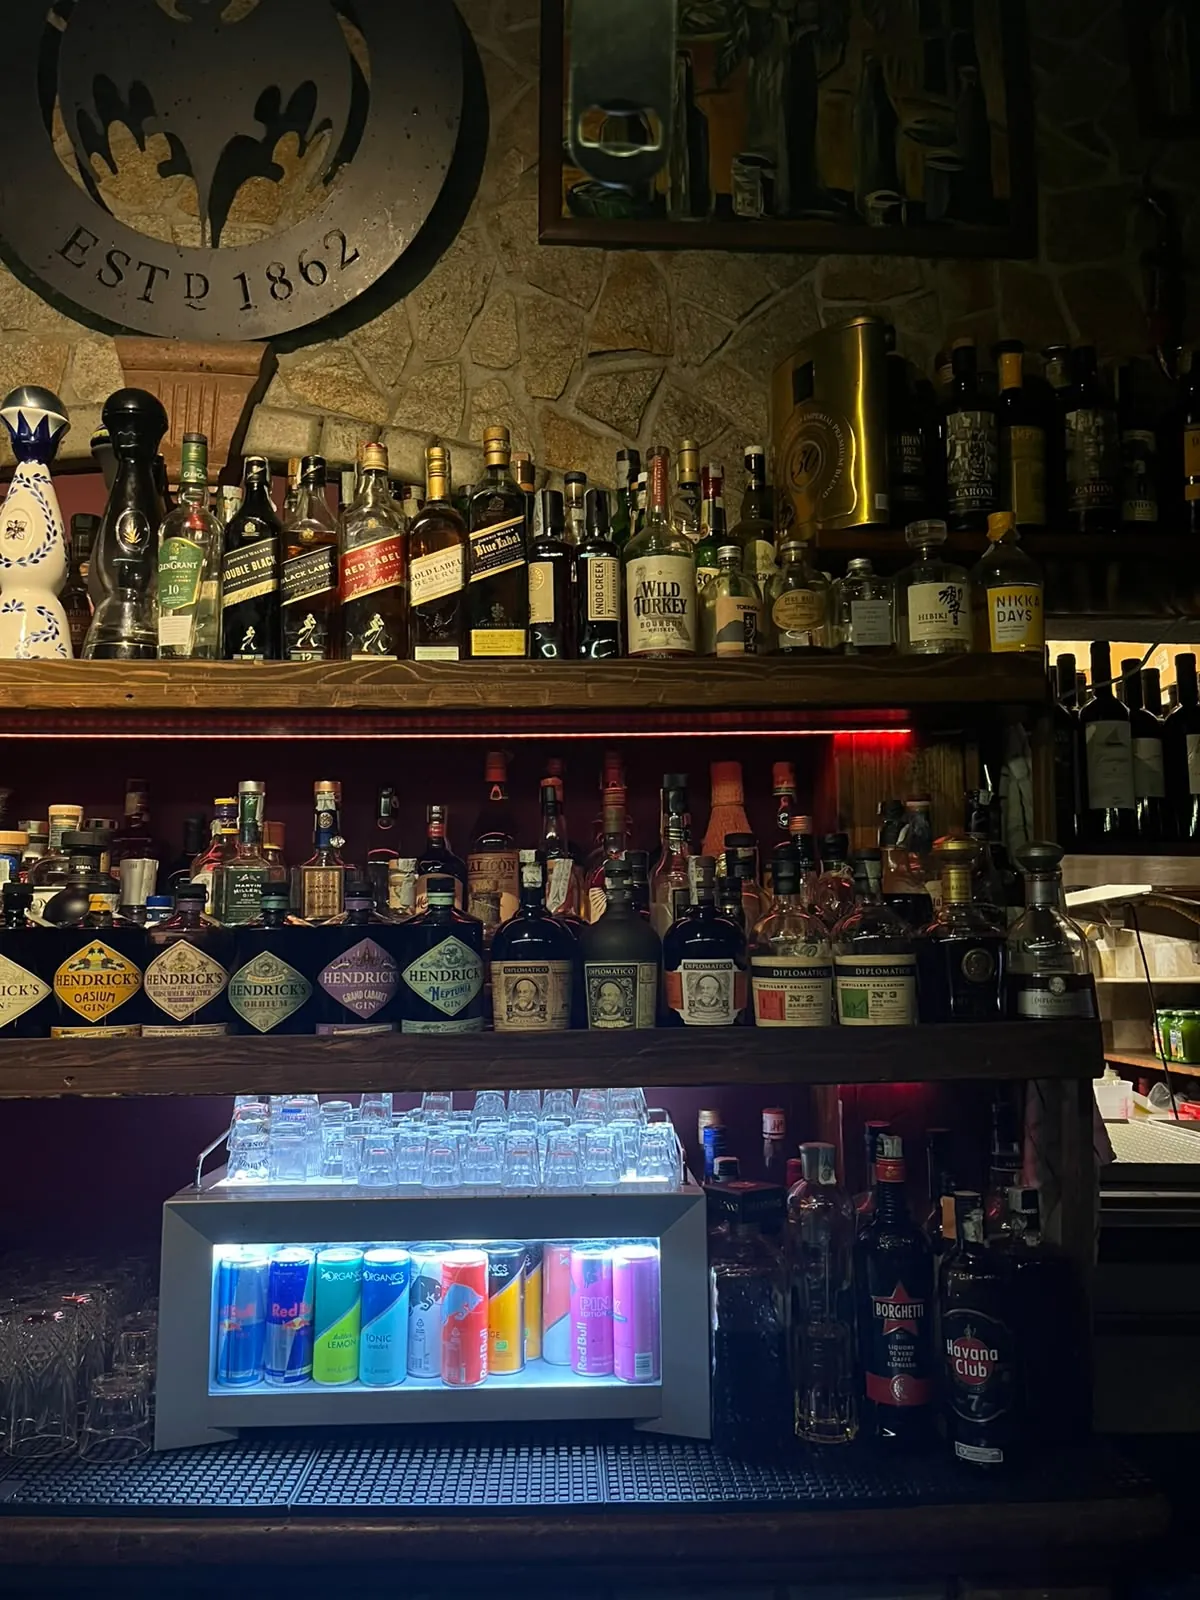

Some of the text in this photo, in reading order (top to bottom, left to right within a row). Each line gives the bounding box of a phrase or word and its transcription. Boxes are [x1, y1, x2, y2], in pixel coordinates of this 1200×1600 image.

[234, 228, 360, 312] 1862
[473, 532, 521, 557] Blue Label
[250, 554, 278, 571] BLACK
[344, 562, 367, 577] RED
[368, 551, 401, 568] LABEL
[167, 584, 180, 595] 10
[595, 562, 604, 616] KNOB CREEK
[642, 580, 681, 598] WILD
[634, 597, 688, 617] TURKEY
[918, 612, 948, 621] HIBIKI
[997, 609, 1032, 623] DAYS
[323, 970, 395, 984] HENDRICK
[409, 967, 480, 982] HENDRICK
[855, 967, 906, 976] DIPLOMATI
[56, 973, 140, 987] HENDRICK'S
[146, 972, 223, 986] HENDRICK'S
[1, 984, 40, 997] ICK'S
[230, 984, 307, 996] HENDRICK'S
[74, 991, 116, 1004] OASIUM
[443, 1000, 462, 1008] GIN
[83, 1003, 106, 1012] GIN
[355, 1001, 377, 1010] GIN
[271, 1302, 299, 1318] Red
[875, 1302, 924, 1319] BORGHETTI
[327, 1338, 357, 1349] LEMON
[366, 1332, 392, 1343] TONIC
[945, 1338, 999, 1361] Havana
[955, 1359, 988, 1378] Club
[967, 1394, 980, 1412] 7
